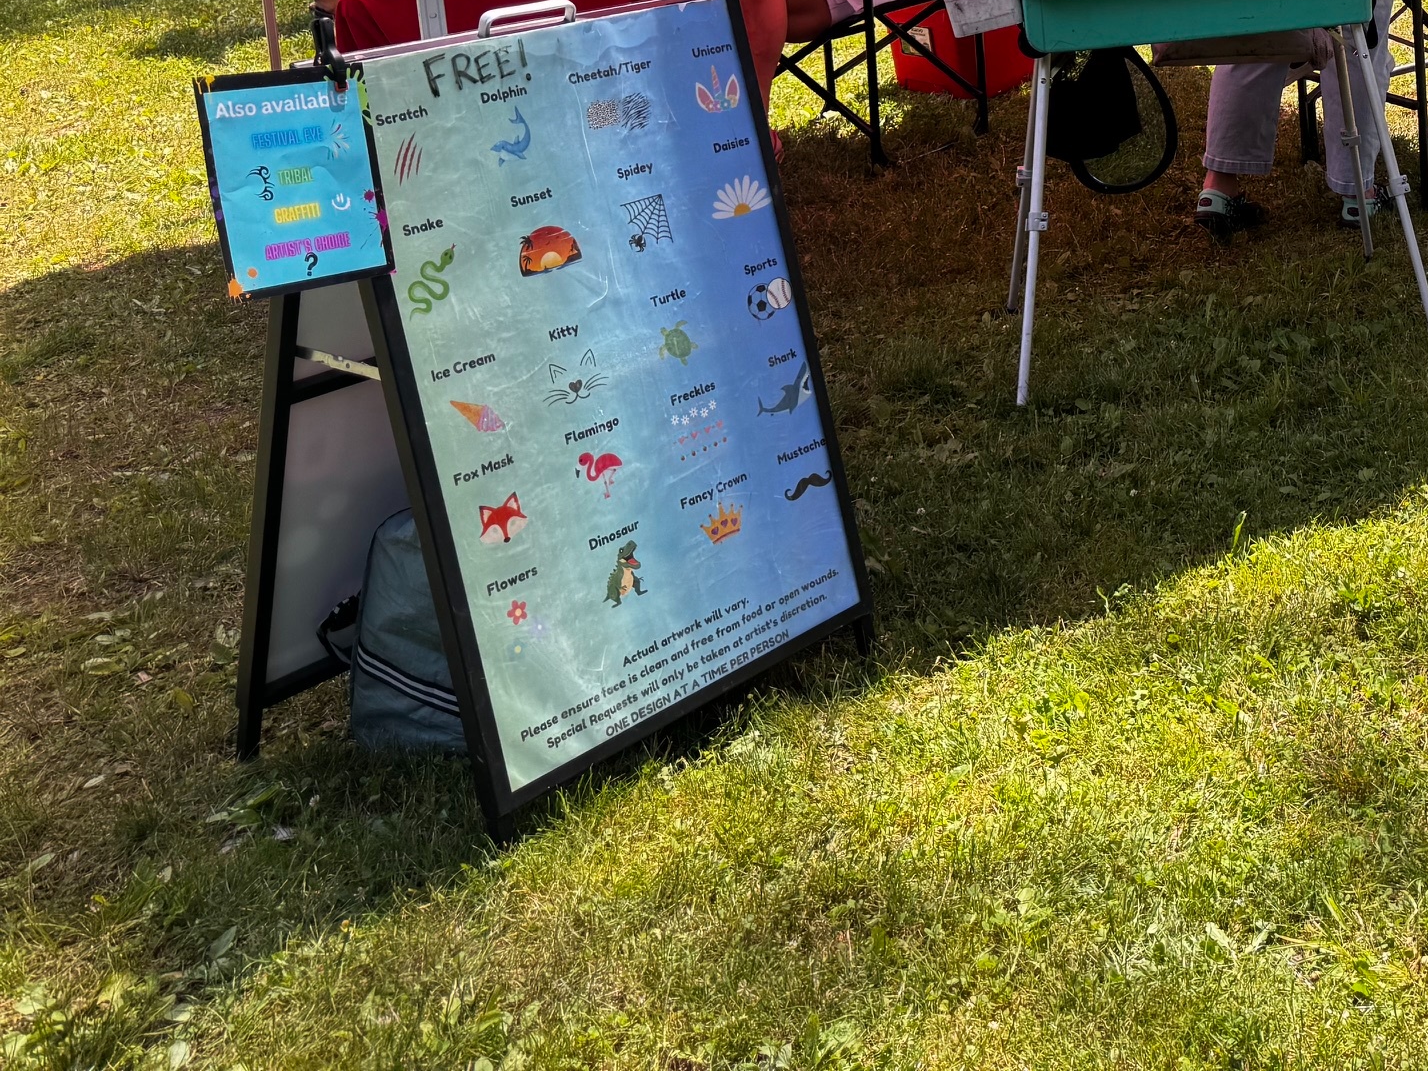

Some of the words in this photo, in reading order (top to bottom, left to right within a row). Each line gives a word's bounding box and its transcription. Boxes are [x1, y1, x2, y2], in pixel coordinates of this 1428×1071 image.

[692, 43, 733, 58] Unicorn
[423, 39, 532, 98] FREE!
[568, 60, 651, 85] Cheetah/Tiger
[215, 101, 257, 119] Also
[261, 91, 348, 114] available
[480, 85, 528, 104] Dolphin
[376, 106, 429, 126] Scratch
[252, 129, 301, 149] FESTIVAL
[303, 126, 323, 143] EYE
[713, 137, 750, 154] Daisies
[277, 167, 314, 185] TRIBAL
[617, 163, 653, 181] Spidey
[510, 188, 553, 208] Sunset
[274, 203, 321, 223] GRAFFITI
[402, 218, 444, 236] Snake
[265, 238, 312, 260] ARTIST'S
[314, 232, 351, 252] CHOICE
[304, 252, 318, 276] ?
[744, 257, 778, 276] Sports
[650, 289, 687, 307] Turtle
[549, 325, 578, 342] Kitty
[431, 368, 451, 382] Ice
[453, 353, 496, 374] Cream
[768, 349, 797, 368] Shark
[670, 382, 716, 406] Freckles
[564, 417, 619, 445] Flamingo
[777, 437, 827, 465] Mustache
[453, 469, 479, 486] Fox
[481, 453, 514, 476] Mask
[680, 488, 714, 509] Fancy
[716, 473, 748, 493] Crown
[588, 521, 640, 551] Dinosaur
[486, 566, 538, 597] Flowers
[623, 640, 659, 667] Actual
[661, 619, 702, 648] artwork
[704, 608, 723, 625] will
[724, 598, 750, 615] vary.
[520, 714, 559, 742] Please
[561, 694, 601, 719] ensure
[601, 680, 626, 698] face
[628, 673, 638, 685] is
[640, 658, 669, 678] clean
[671, 645, 690, 662] and
[690, 633, 714, 651] free
[715, 621, 741, 639] from
[741, 606, 763, 625] food
[765, 600, 777, 612] or
[778, 587, 800, 606] open
[801, 568, 839, 593] wounds.
[547, 719, 587, 749] Special
[589, 693, 639, 727] Requests
[640, 681, 660, 698] will
[661, 667, 685, 687] only
[686, 660, 699, 673] be
[700, 645, 731, 665] taken
[732, 636, 743, 649] at
[744, 618, 779, 642] artist's
[780, 593, 828, 623] discretion.
[605, 716, 630, 737] ONE
[631, 693, 671, 723] DESIGN
[673, 683, 689, 701] AT
[691, 680, 701, 691] A
[701, 663, 729, 684] TIME
[730, 652, 750, 669] PER
[750, 629, 790, 658] PERSON
